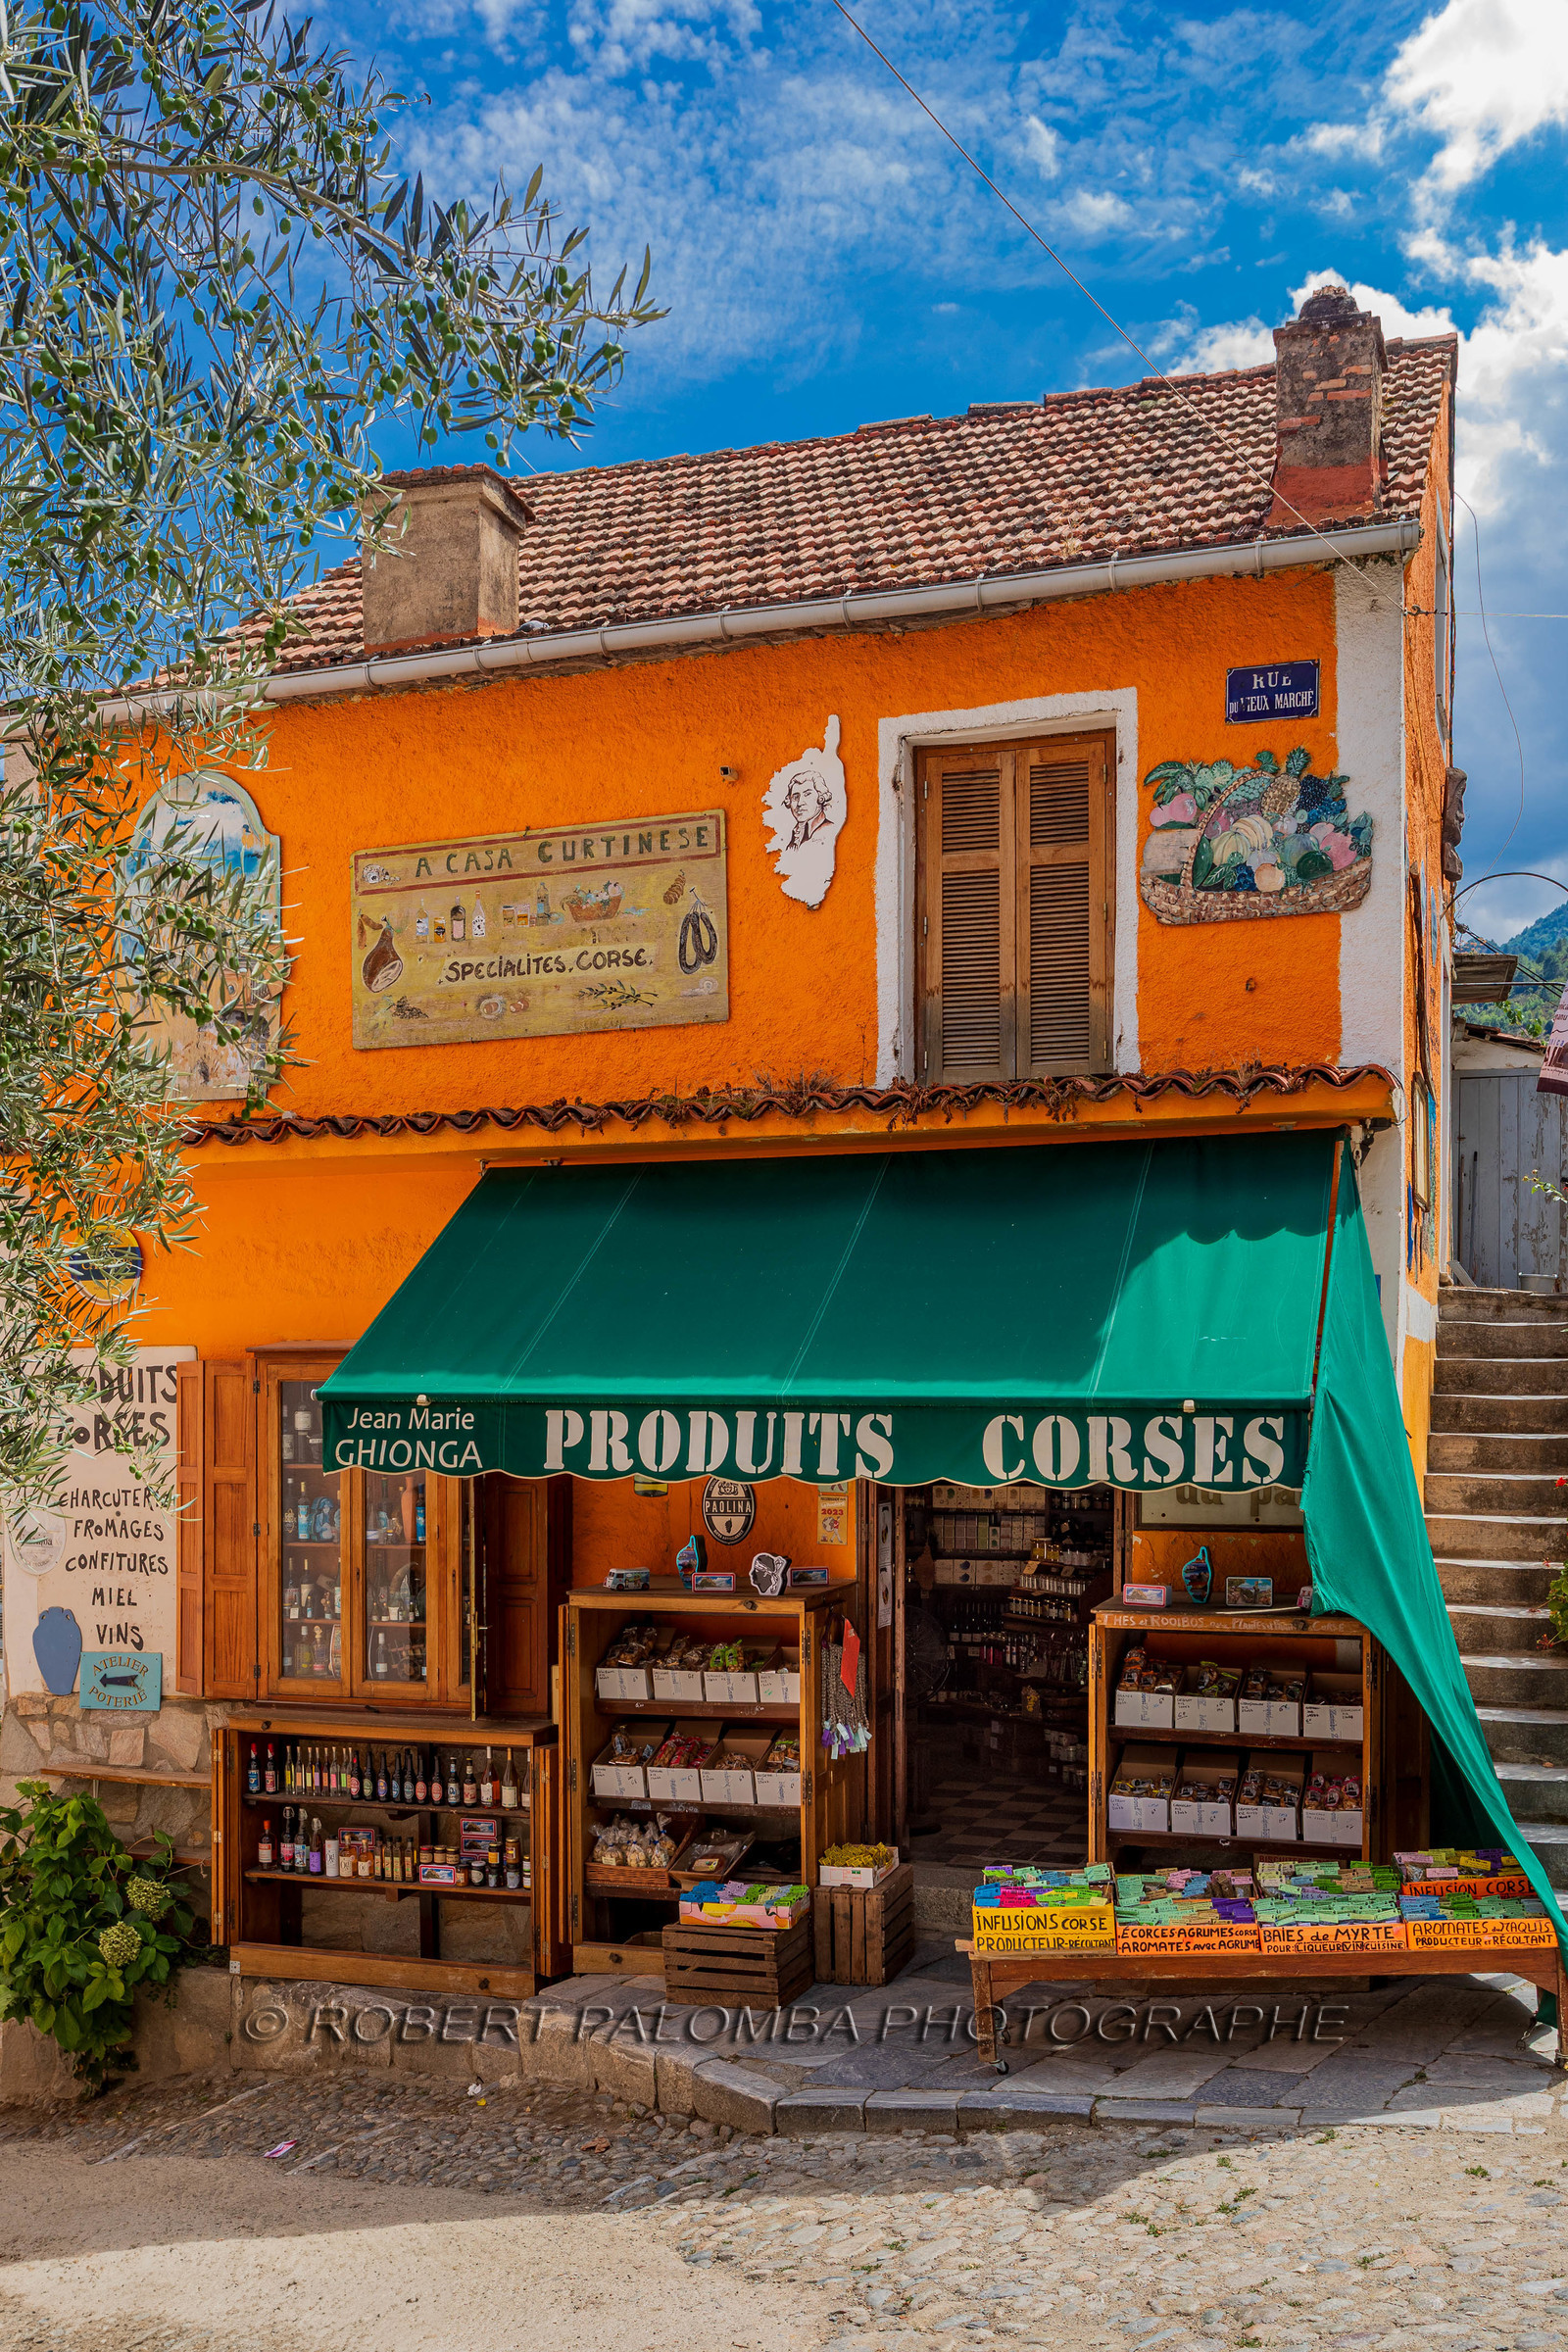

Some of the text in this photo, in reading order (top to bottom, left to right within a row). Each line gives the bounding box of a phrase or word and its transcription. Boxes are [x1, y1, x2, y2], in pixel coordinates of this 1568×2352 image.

[1252, 671, 1292, 690] RUE
[1229, 702, 1239, 713] DU
[1274, 688, 1314, 710] MARCHÉ
[415, 825, 710, 878] A CASA CURTINESE
[347, 1407, 474, 1430] Jean Marie
[335, 1439, 483, 1468] GHIONGA
[543, 1409, 1285, 1484] PRODUITS CORSES
[705, 1500, 752, 1513] PAOLINA
[74, 1518, 165, 1542] FROMAGES
[65, 1550, 169, 1576] CONFITURES
[91, 1587, 137, 1606] MIEL
[96, 1622, 144, 1651] VINS
[93, 1656, 149, 1677] ATELIER
[87, 1686, 148, 1708] POTERIE
[976, 1911, 1108, 1932] INFUSIONS CORSE
[1413, 1921, 1489, 1936] AROMATES
[1263, 1926, 1395, 1942] BAIES de MYRTE
[1416, 1936, 1482, 1945] PRODUCTEUR
[1493, 1935, 1553, 1944] RÉCOLTANT
